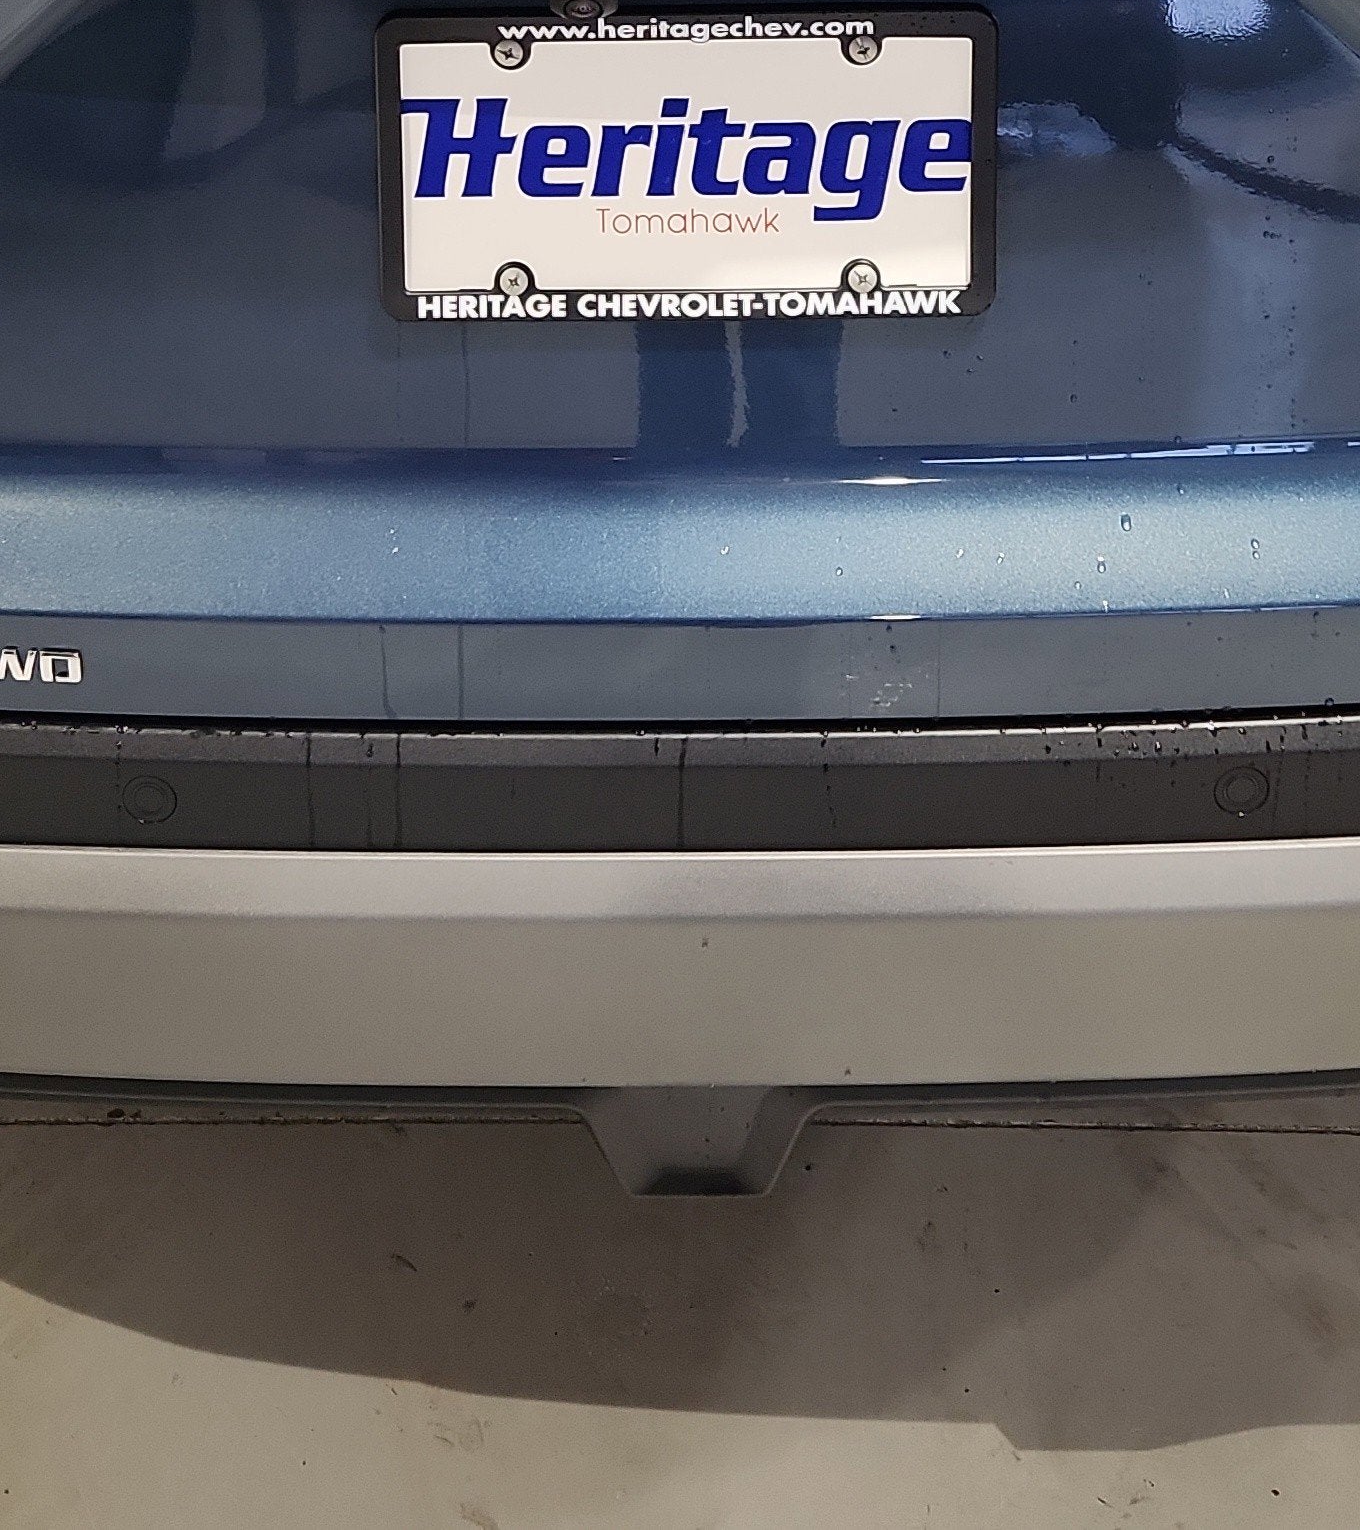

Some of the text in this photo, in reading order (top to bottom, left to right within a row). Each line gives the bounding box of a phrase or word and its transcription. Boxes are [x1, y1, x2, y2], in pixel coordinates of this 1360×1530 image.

[498, 17, 874, 42] www.heritagechev.com
[400, 98, 972, 222] Heritage
[596, 207, 780, 234] Tomahawk
[418, 291, 961, 319] HERITAGE CHEVROLET-TOMAHAWK
